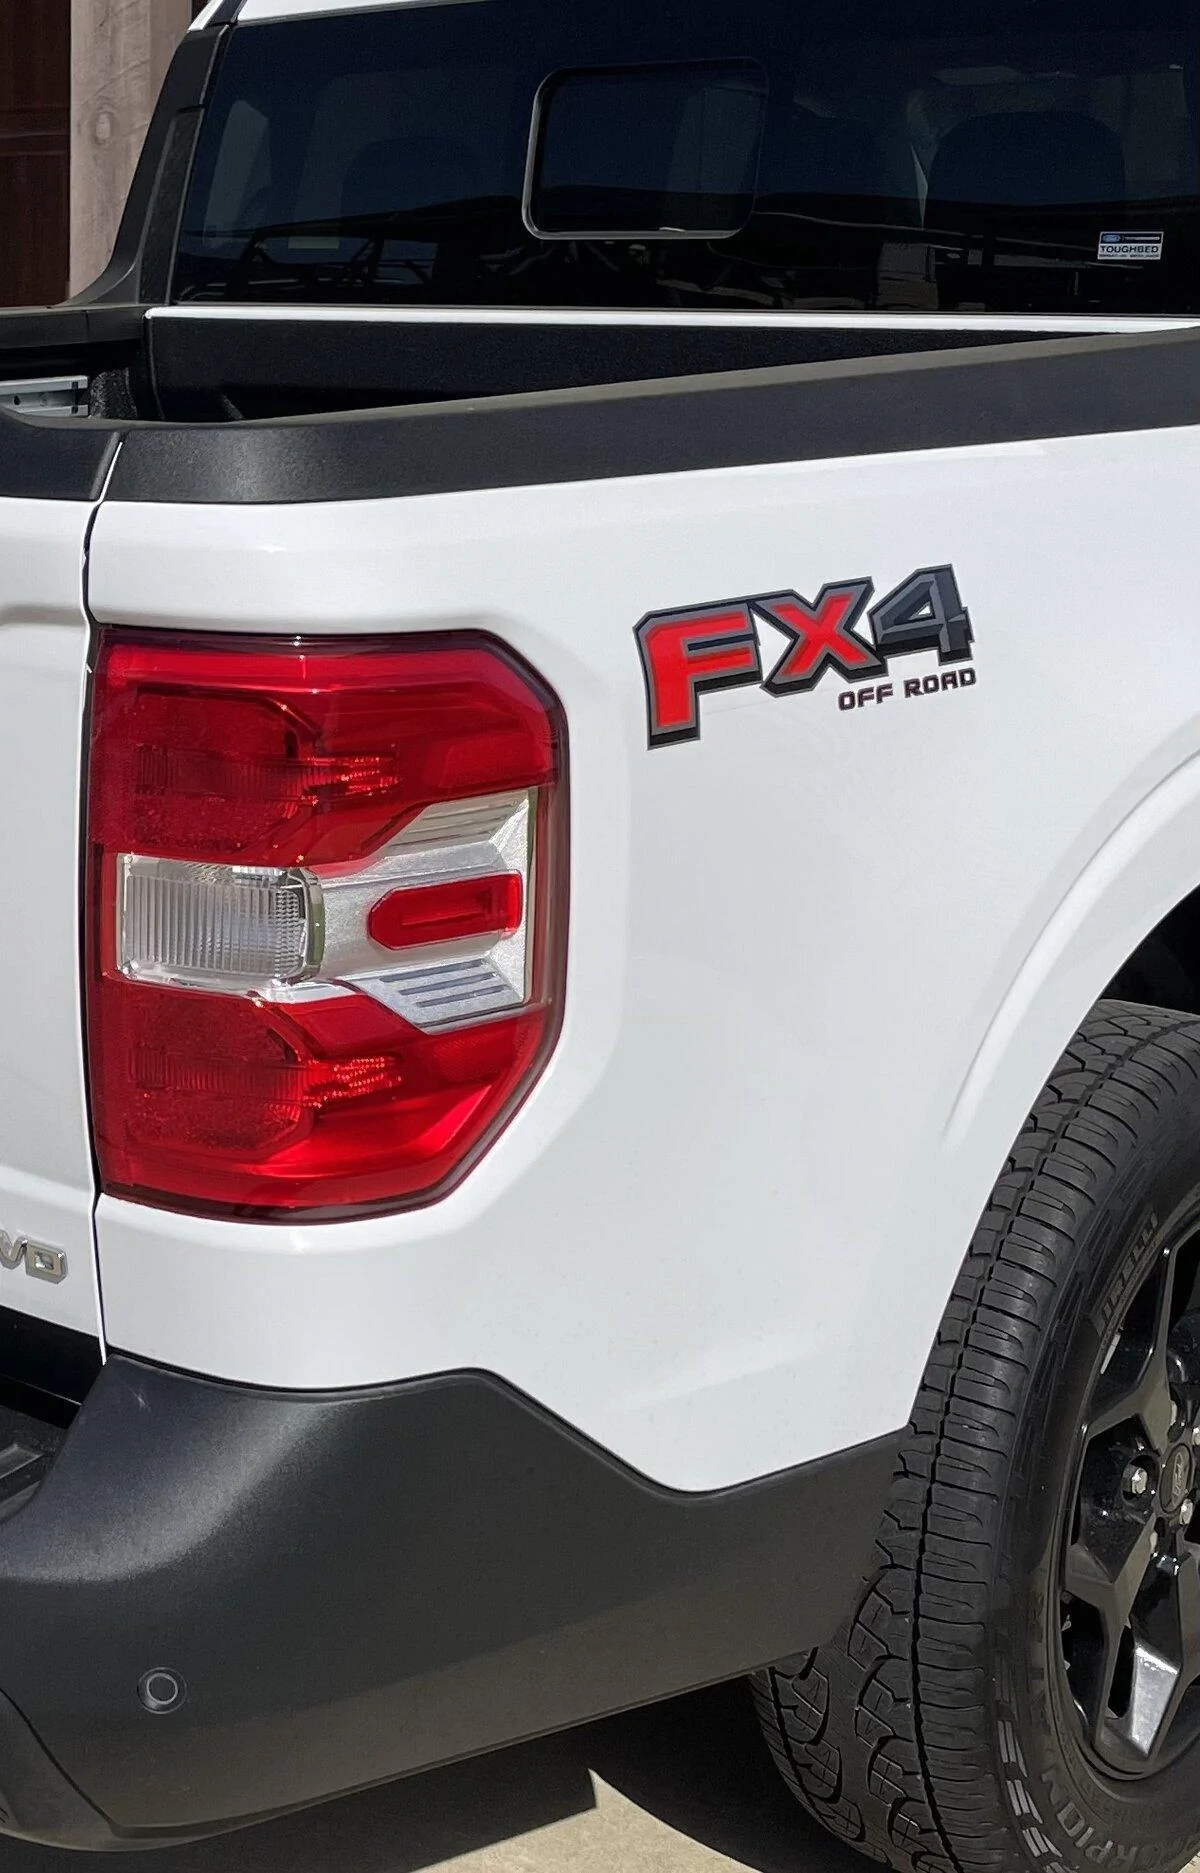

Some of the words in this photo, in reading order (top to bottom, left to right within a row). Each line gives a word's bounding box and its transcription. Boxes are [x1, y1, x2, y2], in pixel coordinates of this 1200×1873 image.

[1099, 245, 1159, 253] TOUGHBED
[633, 564, 975, 750] FX4
[838, 683, 894, 711] OFF
[903, 667, 976, 698] ROAD
